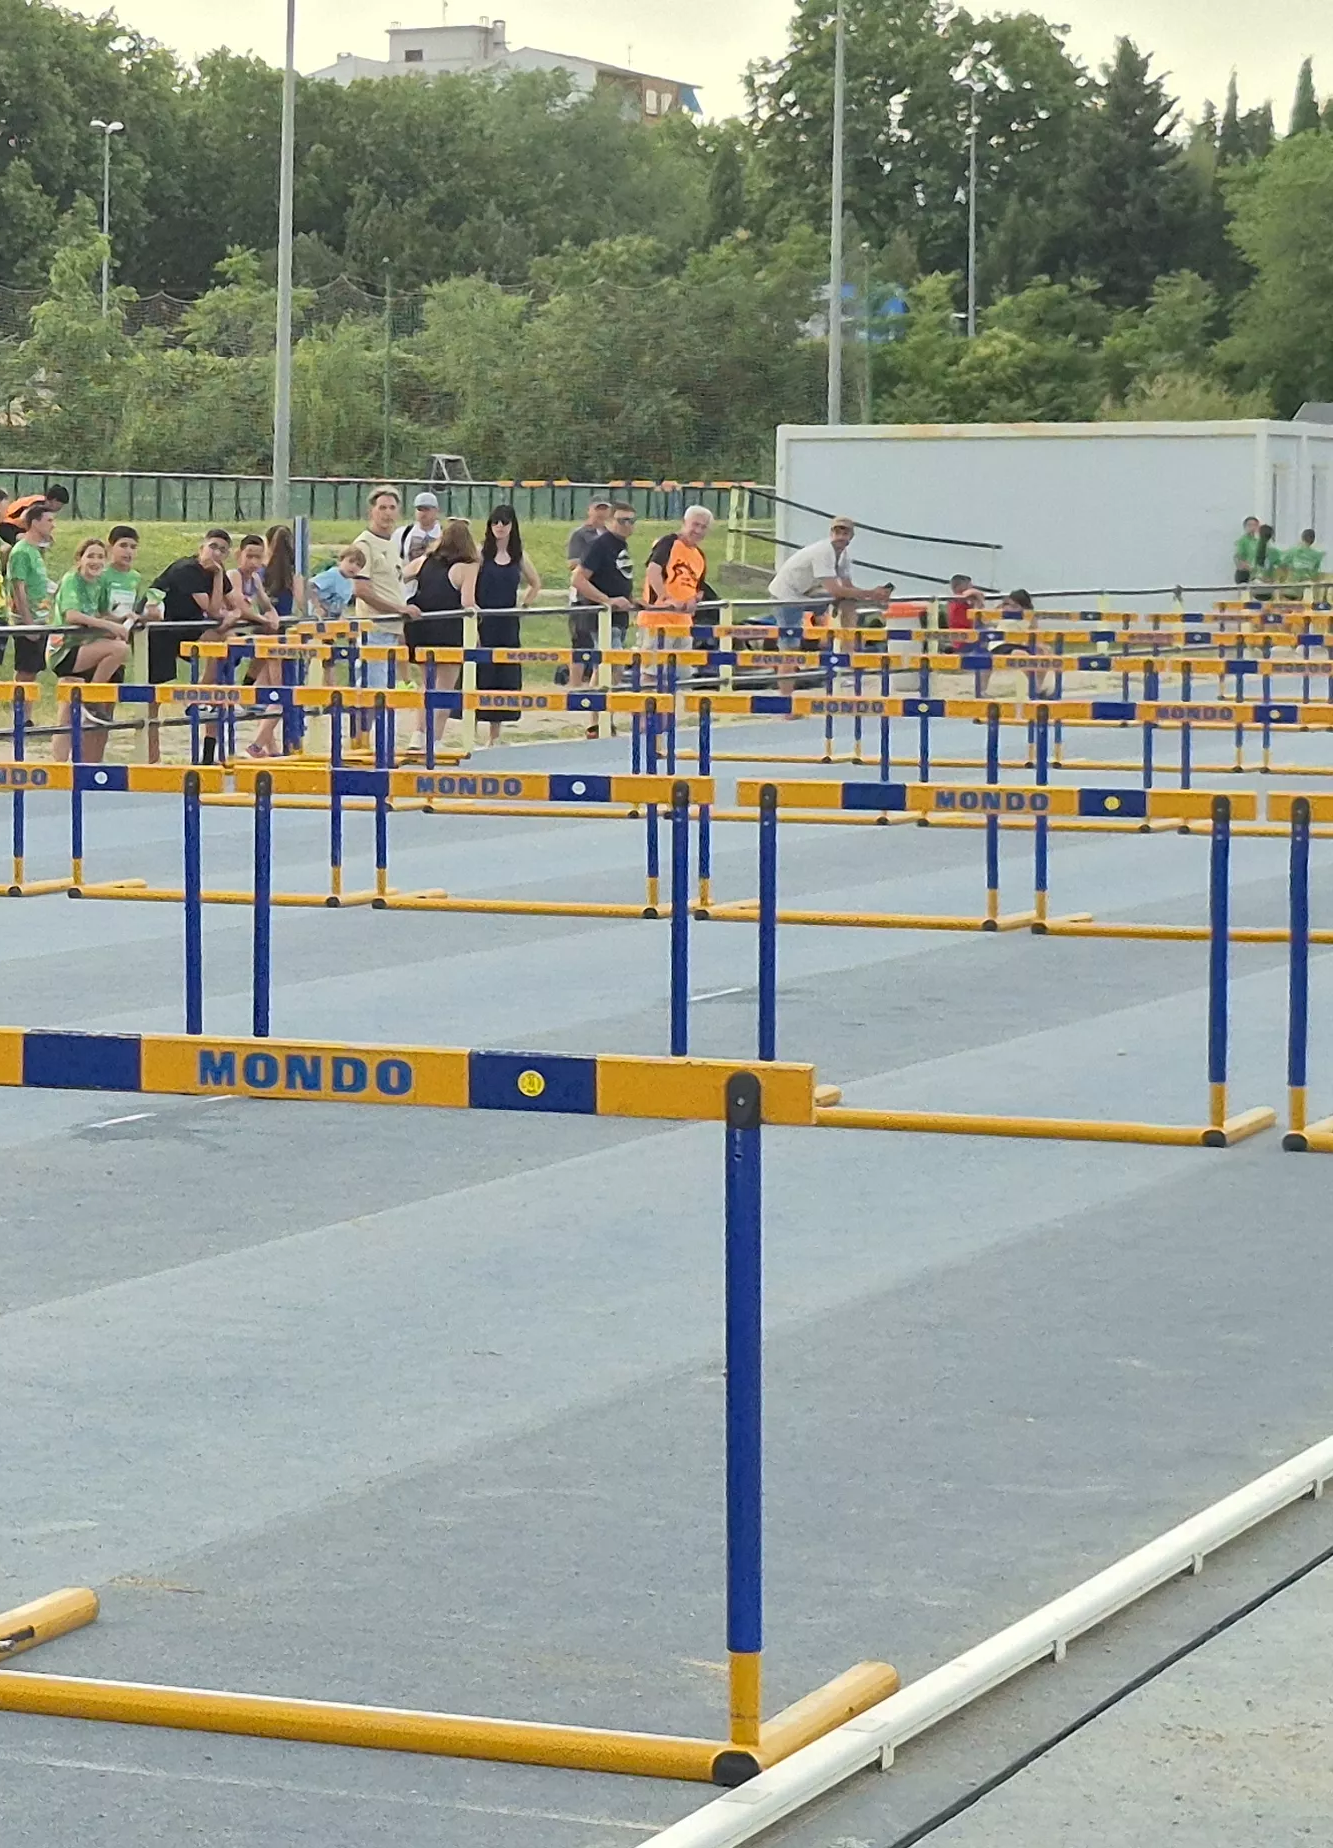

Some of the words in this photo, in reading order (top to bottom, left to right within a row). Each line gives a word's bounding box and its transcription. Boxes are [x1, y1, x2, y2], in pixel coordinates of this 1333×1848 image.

[173, 689, 240, 701] MONDO
[478, 696, 547, 708] MONDO
[810, 701, 883, 713] MONDO
[1156, 706, 1233, 721] MONDO
[417, 777, 522, 796] MONDO
[935, 791, 1049, 811] MONDO
[199, 1050, 412, 1096] MONDO
